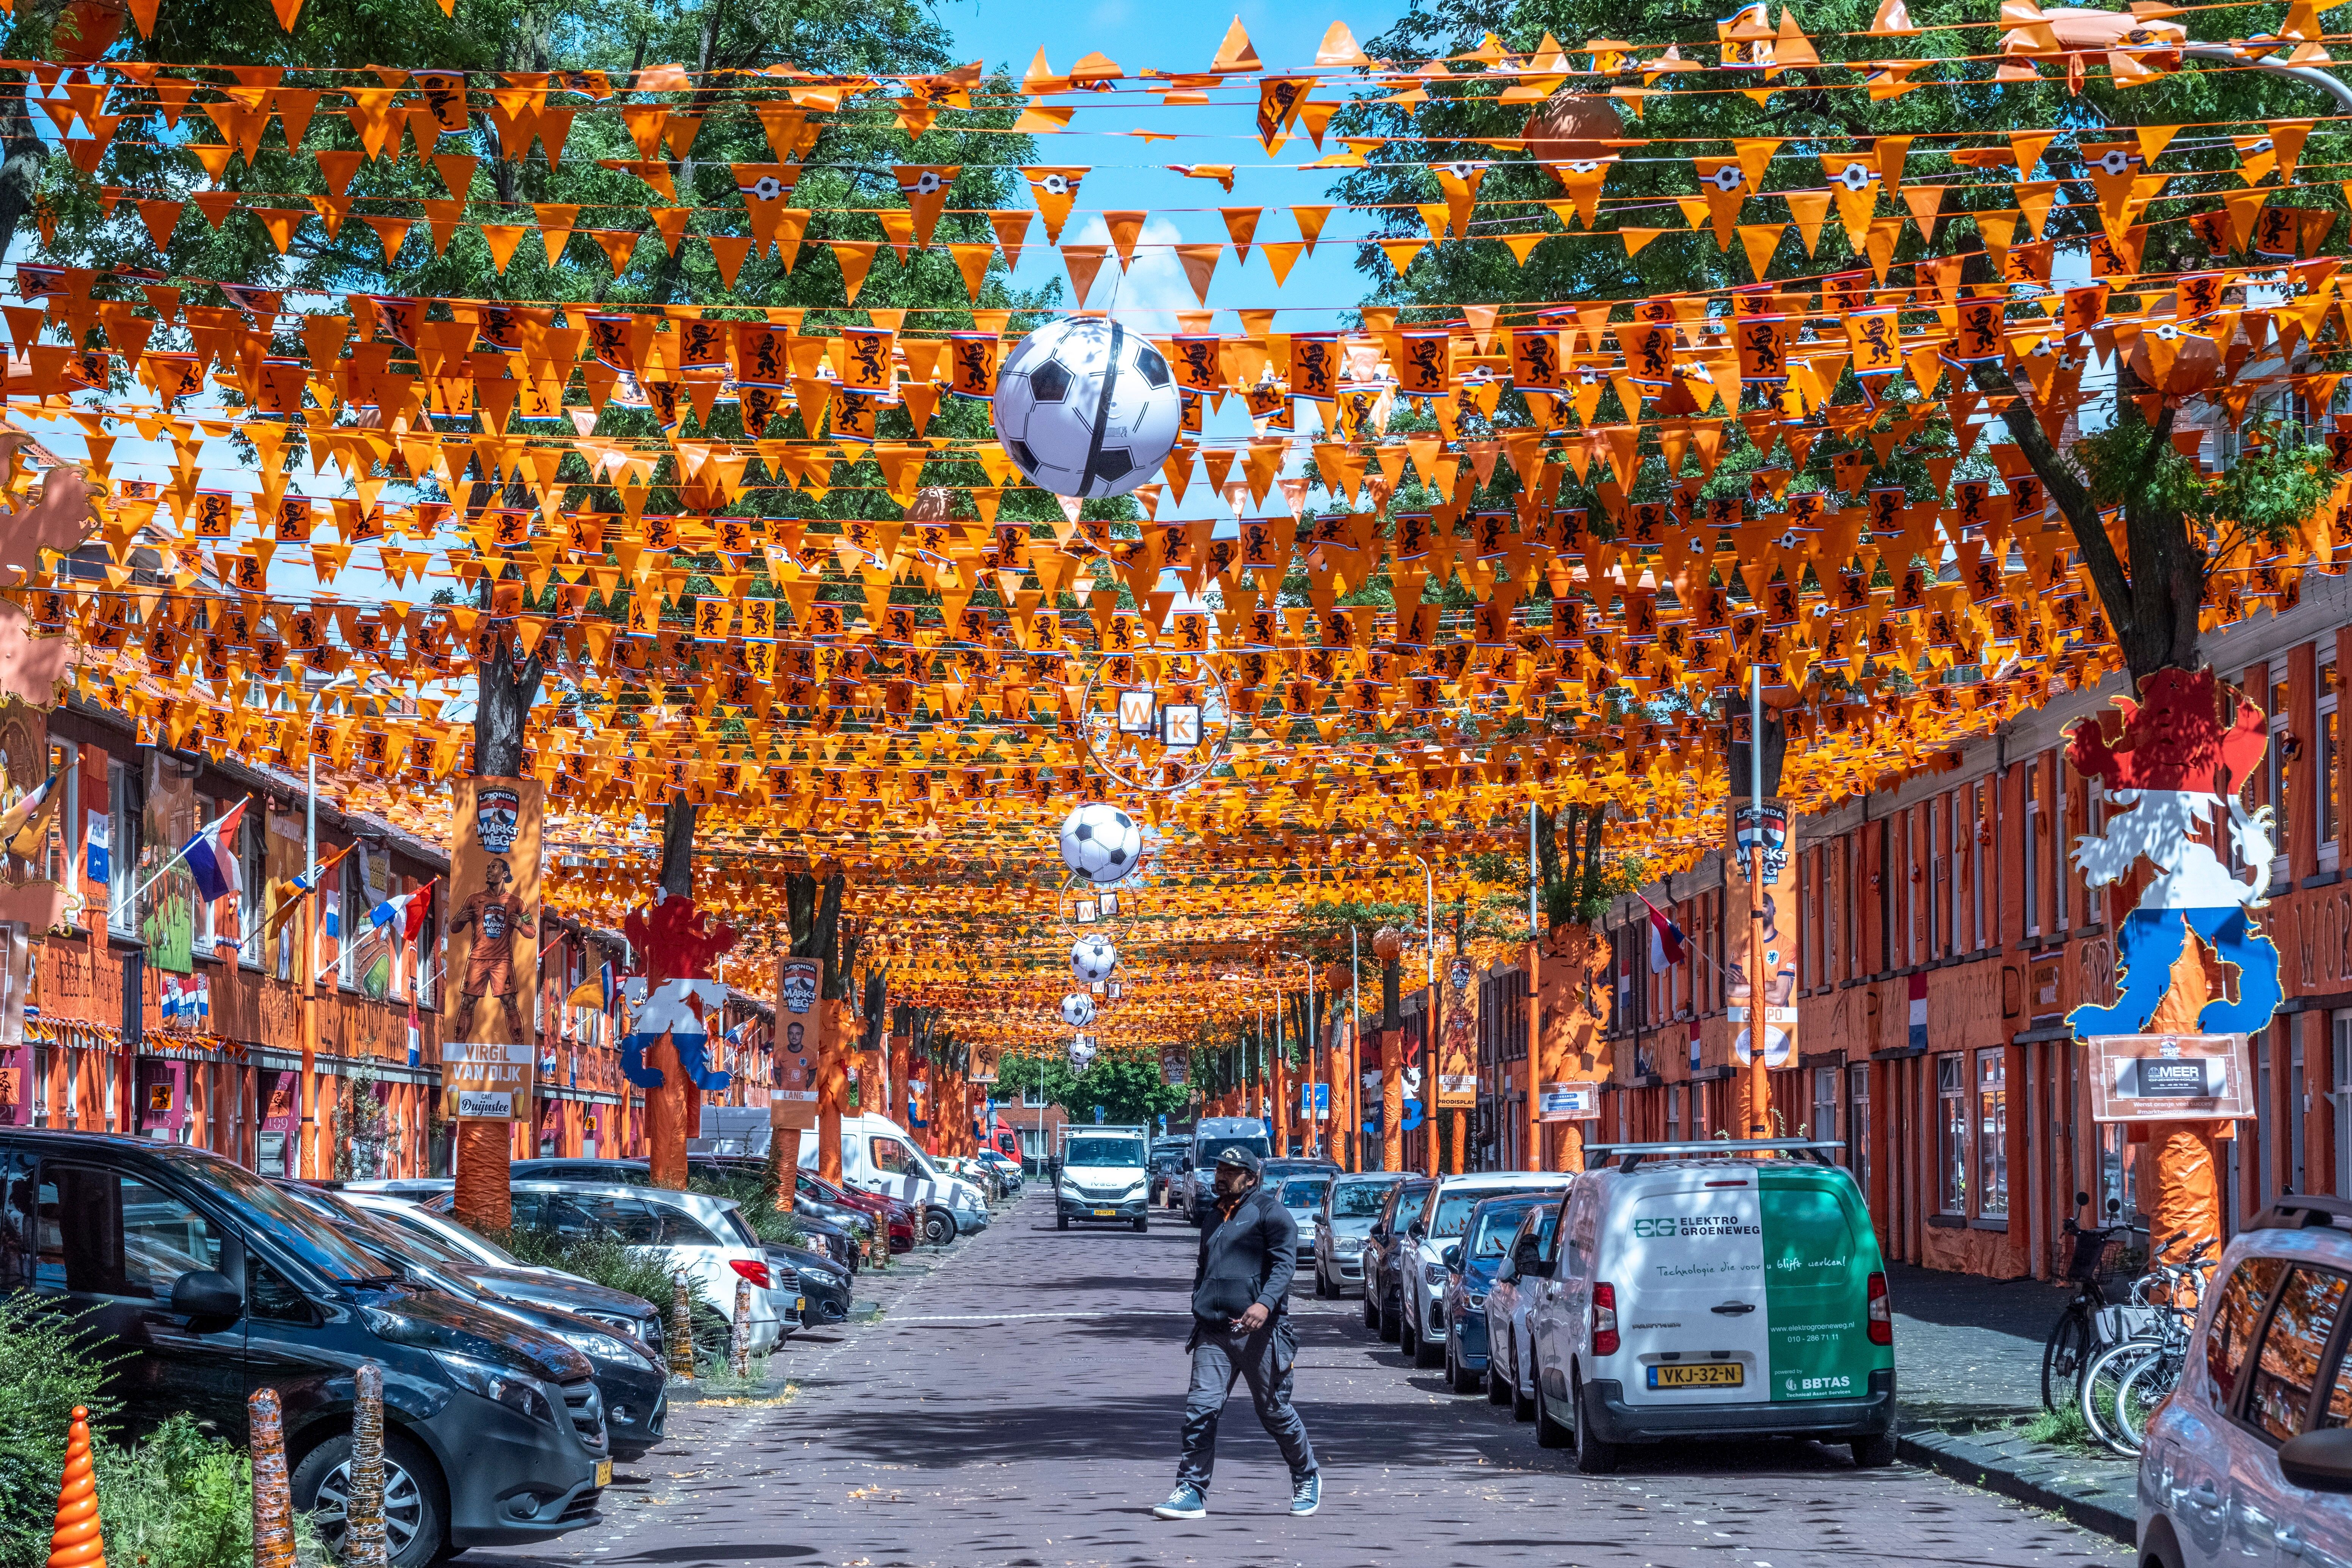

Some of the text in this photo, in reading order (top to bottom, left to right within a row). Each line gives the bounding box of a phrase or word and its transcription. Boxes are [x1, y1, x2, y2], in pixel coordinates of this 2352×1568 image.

[477, 822, 520, 835] MARKT
[483, 833, 509, 846] WEG
[1735, 845, 1790, 863] MRKT
[1744, 861, 1777, 876] WG
[505, 975, 512, 986] 4
[783, 988, 817, 999] MARKT
[788, 996, 809, 1008] WEG
[1742, 1008, 1782, 1021] GPO
[465, 1045, 510, 1061] VIRGIL
[453, 1064, 521, 1082] VAN DIJK
[2160, 1066, 2199, 1077] MEER
[784, 1091, 804, 1100] LANG
[461, 1098, 509, 1116] Duijnstee
[151, 1113, 171, 1126] 115
[267, 1117, 288, 1129] 109
[1680, 1216, 1738, 1226] ELEKTRO
[1681, 1225, 1760, 1236] GROENEWEG
[1656, 1263, 1715, 1277] Technologie
[1720, 1262, 1736, 1271] die
[1777, 1257, 1802, 1271] blijft
[1808, 1256, 1846, 1267] werken!
[1770, 1321, 1855, 1332] www.elektrogroeneweg.nl
[1664, 1367, 1735, 1383] VKJ-32-N
[1802, 1376, 1850, 1389] BBTAS
